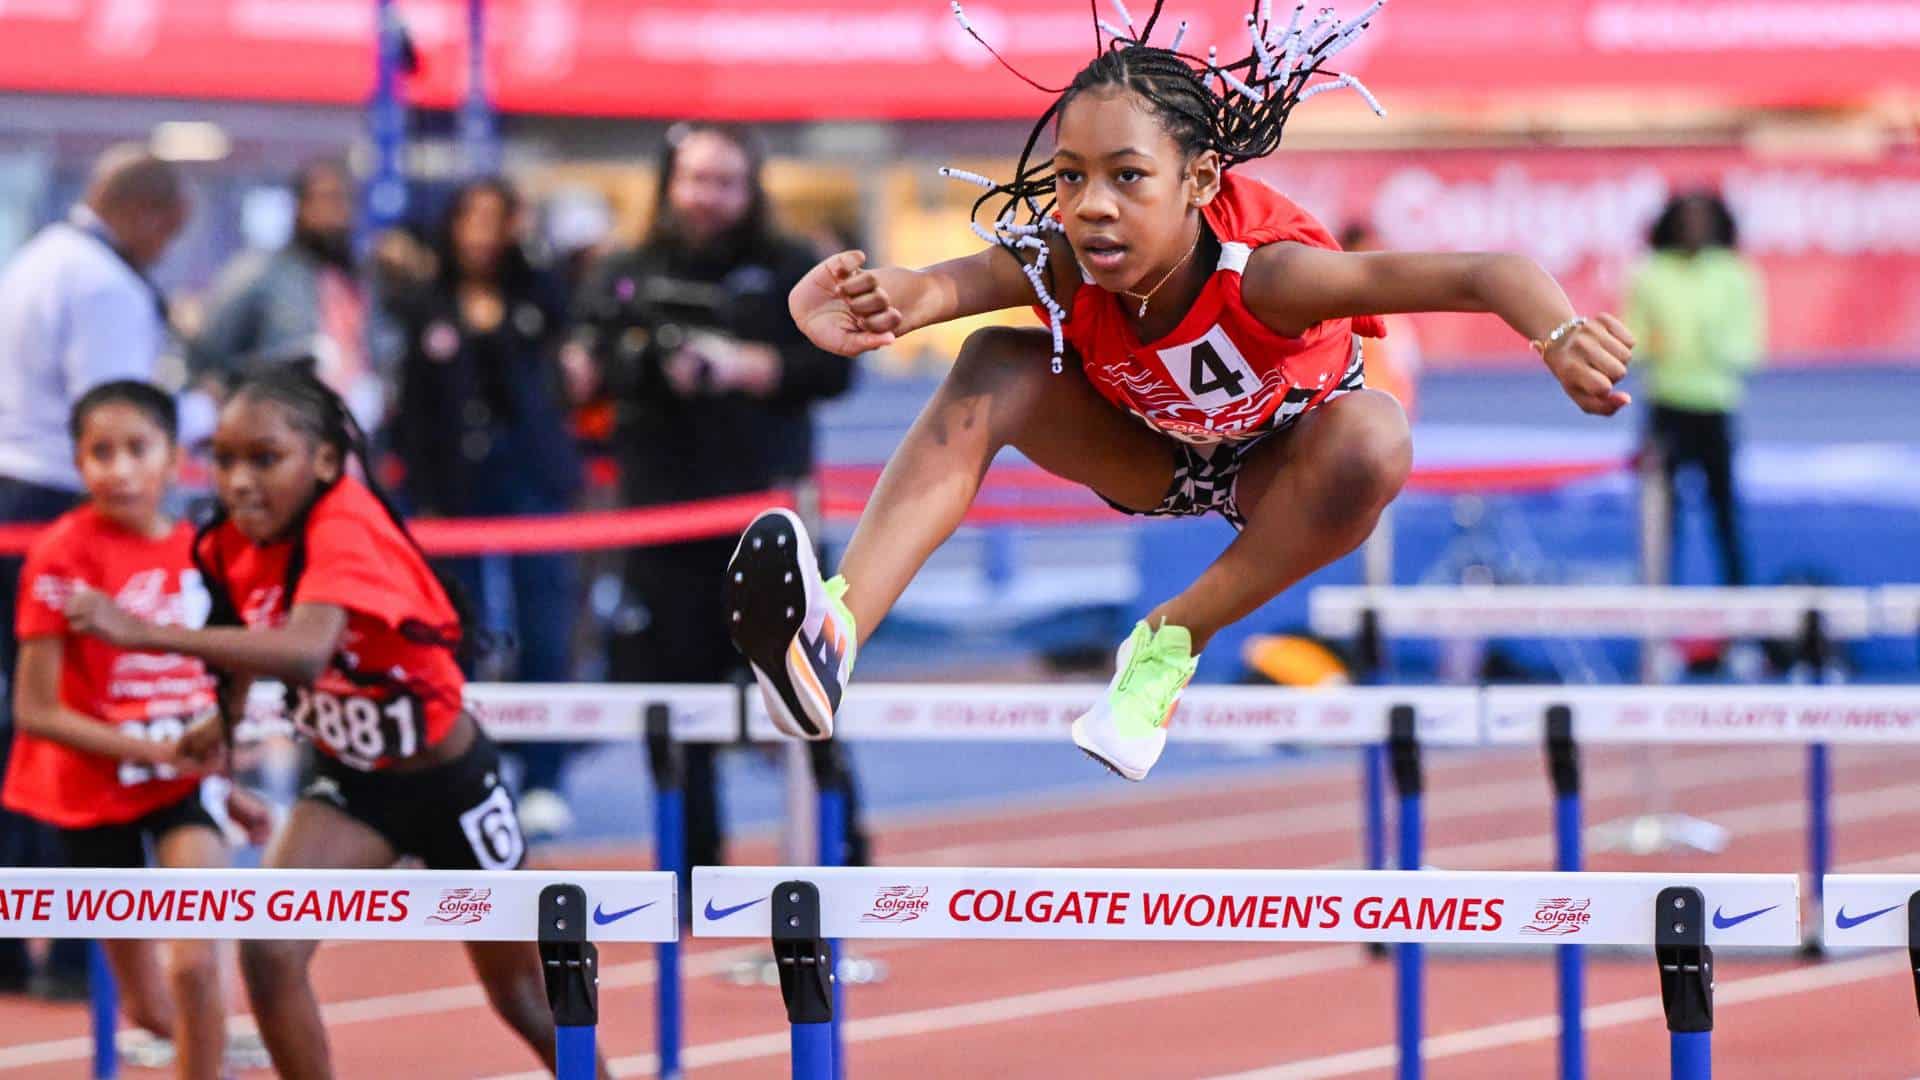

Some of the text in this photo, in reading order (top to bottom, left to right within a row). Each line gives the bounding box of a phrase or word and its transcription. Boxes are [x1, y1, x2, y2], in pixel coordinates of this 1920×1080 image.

[1190, 340, 1245, 398] 4
[475, 806, 512, 864] 6
[66, 889, 257, 922] WOMEN'S
[266, 889, 410, 922] GAMES
[438, 899, 493, 914] Colgate
[875, 898, 929, 911] Colgate
[948, 888, 1505, 931] COLGATE WOMEN'S GAMES
[1535, 910, 1591, 924] Colgate
